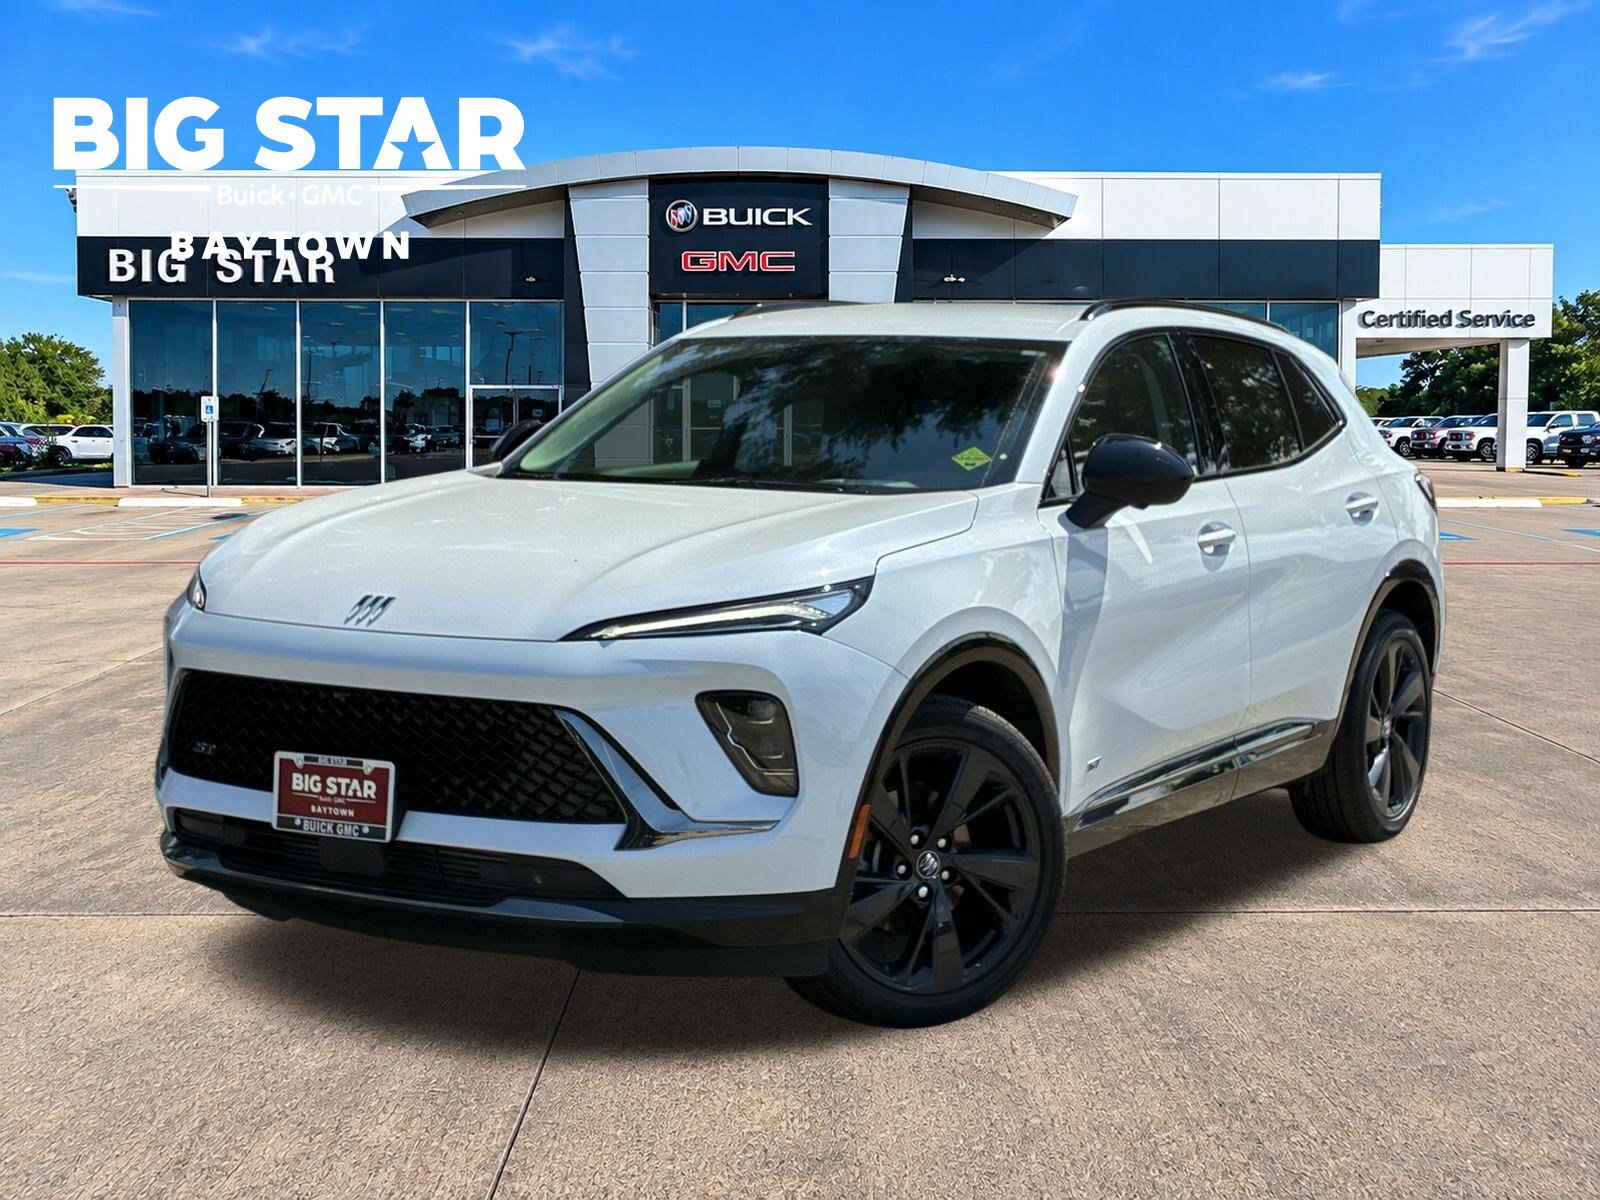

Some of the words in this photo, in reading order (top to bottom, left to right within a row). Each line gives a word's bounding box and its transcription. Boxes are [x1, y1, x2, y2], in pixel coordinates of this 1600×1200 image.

[703, 208, 813, 226] BUICK
[108, 248, 187, 283] BIG
[215, 248, 335, 283] STAR
[681, 251, 795, 271] GMC
[1360, 309, 1452, 328] Certified
[1455, 309, 1536, 328] Service
[291, 772, 322, 794] BIG
[325, 776, 377, 799] STAR
[310, 804, 355, 818] BAYTOWN
[303, 819, 334, 836] BUICK
[336, 823, 360, 838] GMC
